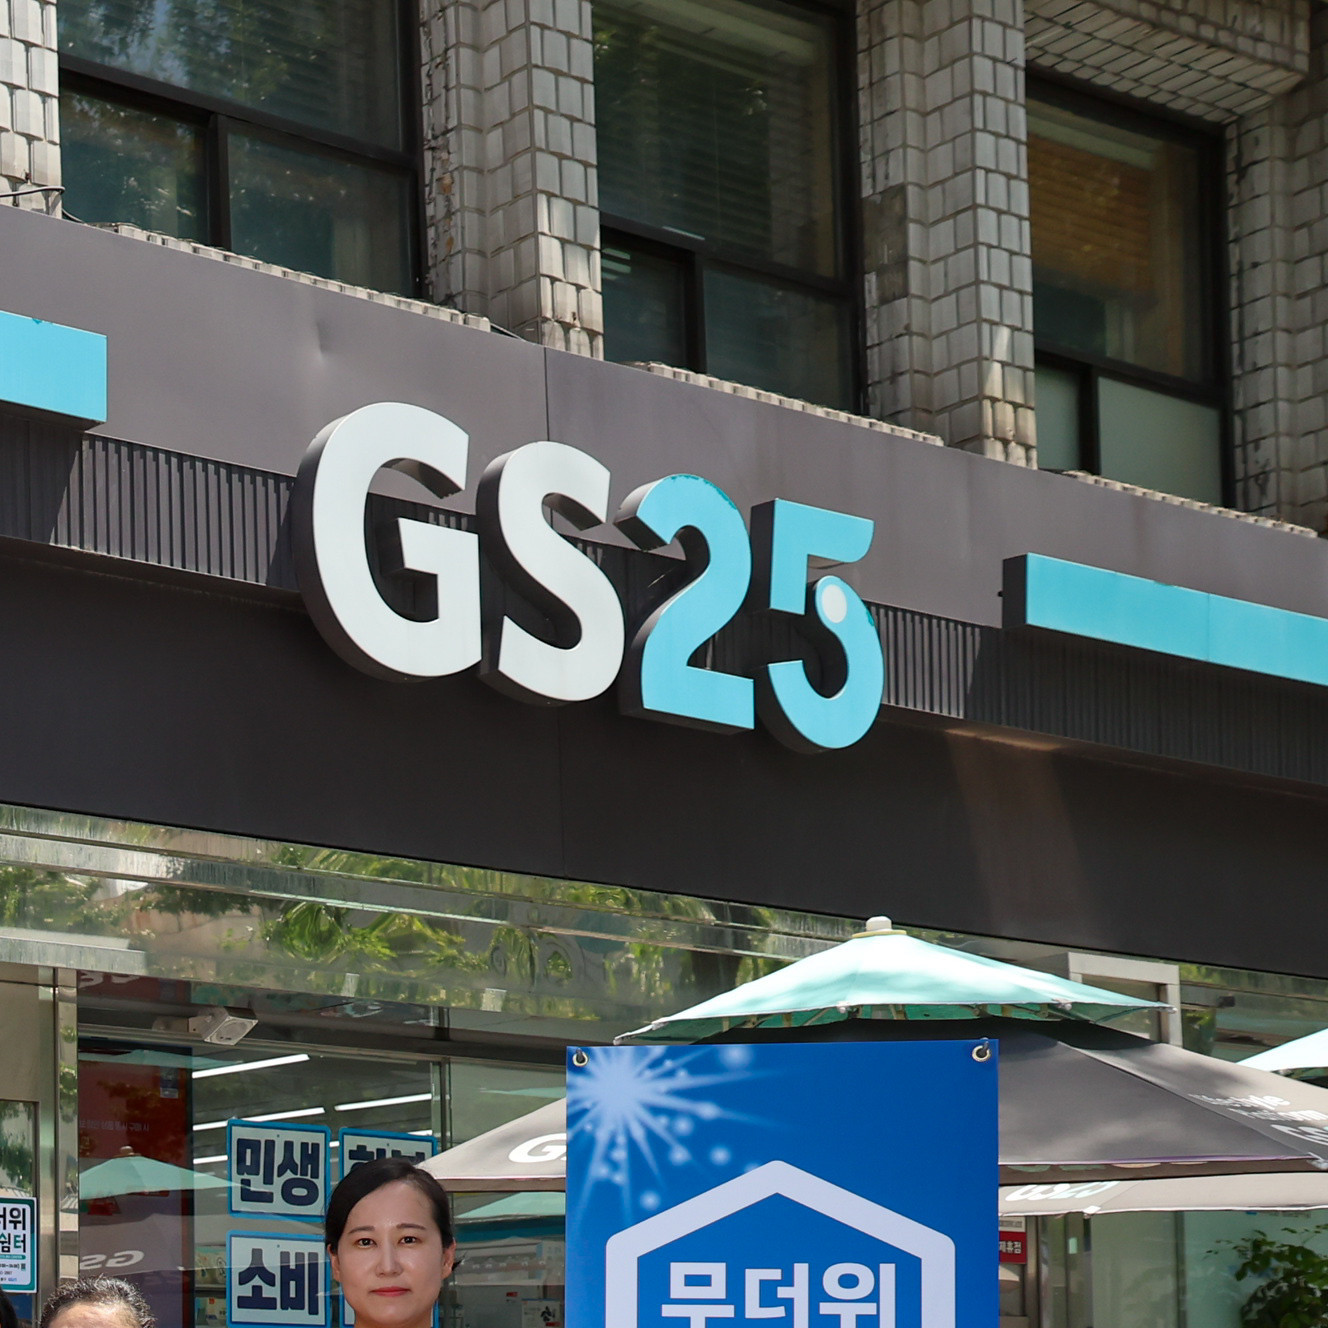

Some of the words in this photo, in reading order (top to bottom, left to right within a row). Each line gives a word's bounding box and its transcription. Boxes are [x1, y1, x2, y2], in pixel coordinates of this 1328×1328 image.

[304, 401, 884, 750] GS25
[236, 1137, 320, 1207] 민생
[236, 1247, 320, 1316] 소비
